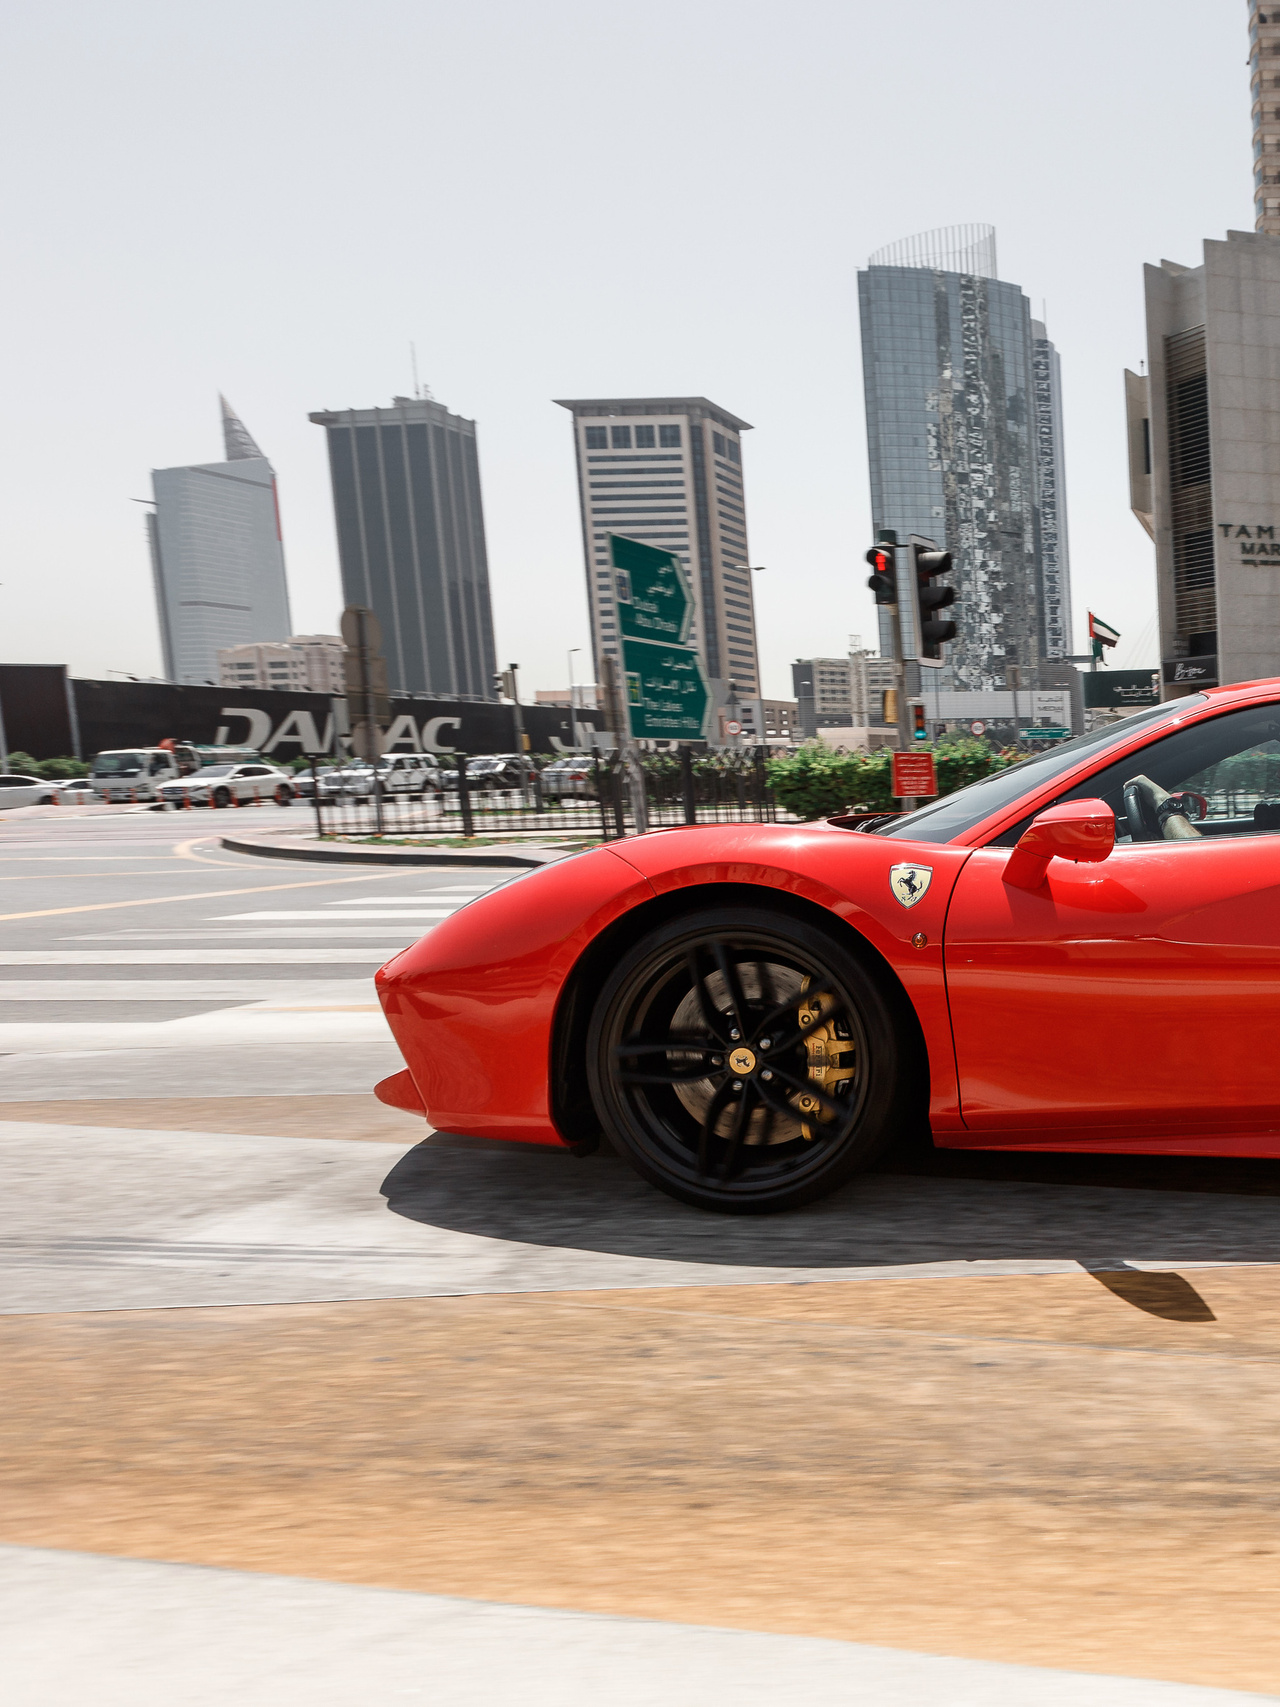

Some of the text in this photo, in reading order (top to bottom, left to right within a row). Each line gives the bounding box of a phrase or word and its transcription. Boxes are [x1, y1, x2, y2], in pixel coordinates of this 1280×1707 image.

[642, 697, 683, 712] The Lakes
[645, 713, 700, 729] Emirates Hills
[214, 707, 462, 754] DAAC
